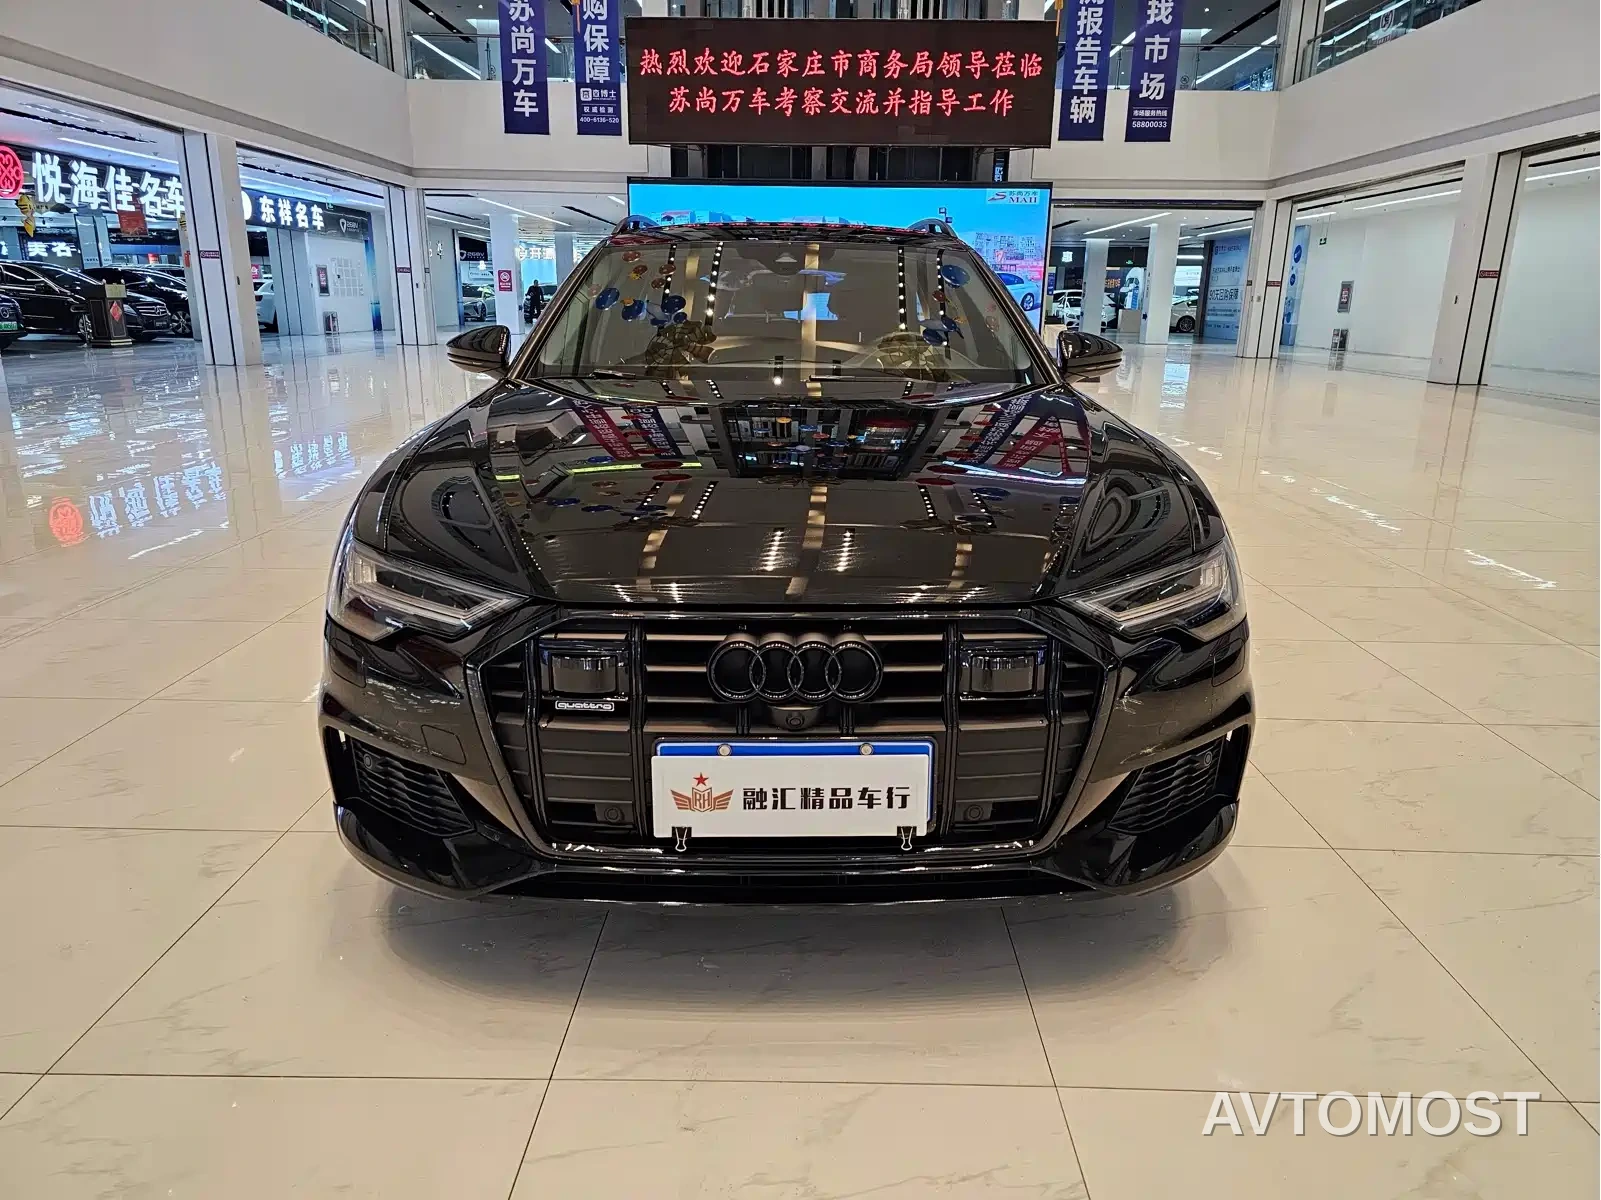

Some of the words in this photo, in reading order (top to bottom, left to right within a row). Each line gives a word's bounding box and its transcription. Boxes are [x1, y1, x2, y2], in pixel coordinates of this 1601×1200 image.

[508, 0, 539, 118] 苏尚万车
[583, 0, 611, 84] 购保障
[640, 47, 1043, 80] 热烈欢迎石家庄市商务局领导莅临
[1070, 0, 1104, 123] 报告车辆
[668, 85, 1016, 118] 苏尚万车考察交流并指导工作
[32, 151, 185, 219] 悦海佳名车
[259, 195, 325, 230] 东祥名车
[557, 702, 612, 710] quattro
[742, 786, 911, 811] 融汇精品车行
